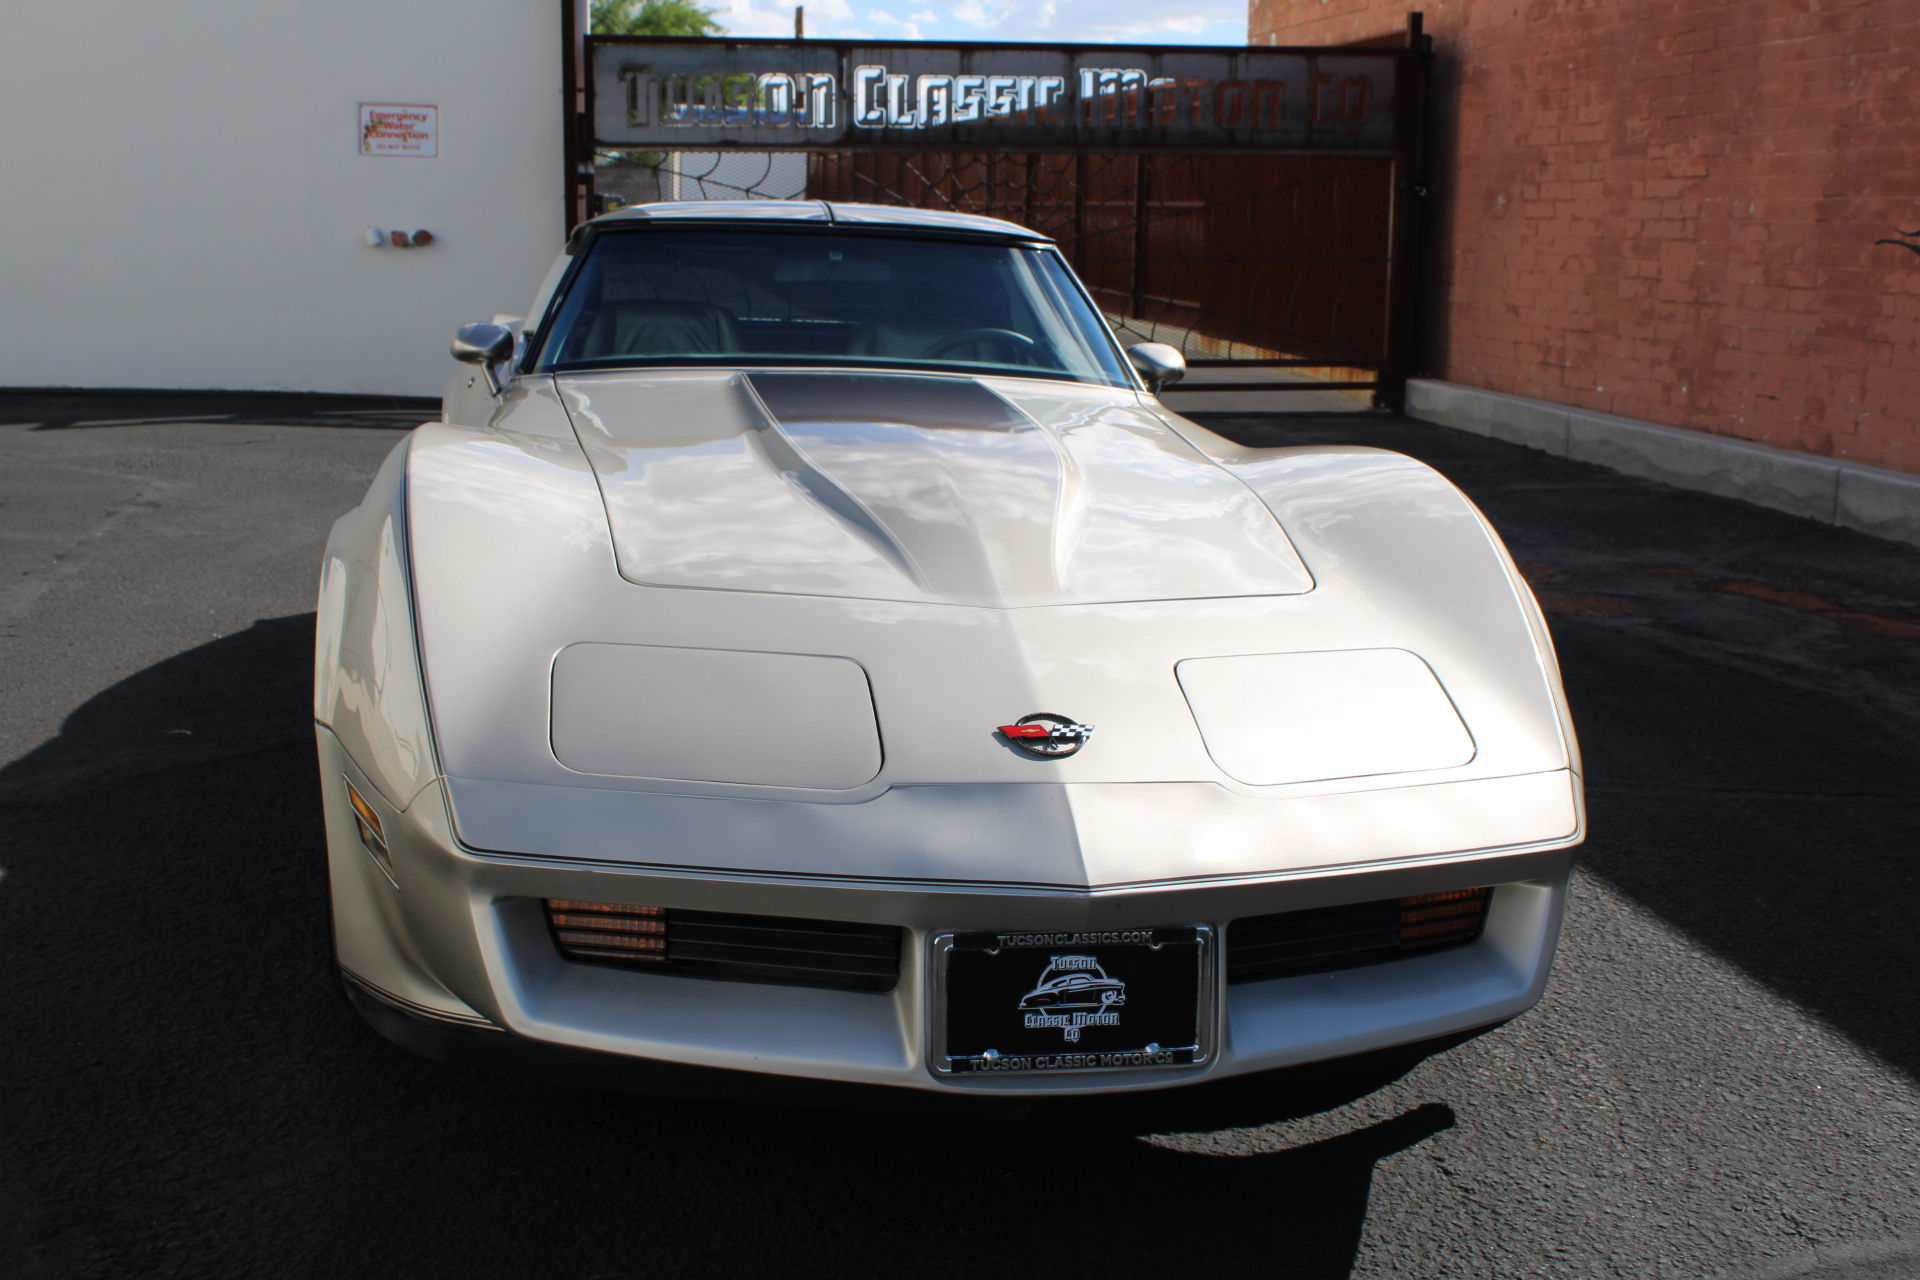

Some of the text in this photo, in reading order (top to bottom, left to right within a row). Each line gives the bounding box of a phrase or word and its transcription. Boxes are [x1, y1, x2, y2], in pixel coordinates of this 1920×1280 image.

[369, 110, 428, 123] Emergency
[382, 121, 416, 130] Water
[368, 130, 429, 140] Connection
[996, 931, 1153, 947] TUCSONCLASSICS.COM
[969, 1057, 1032, 1071] TUCSON
[1035, 1055, 1096, 1069] CLASSIC
[1100, 1053, 1153, 1066] MOTOR
